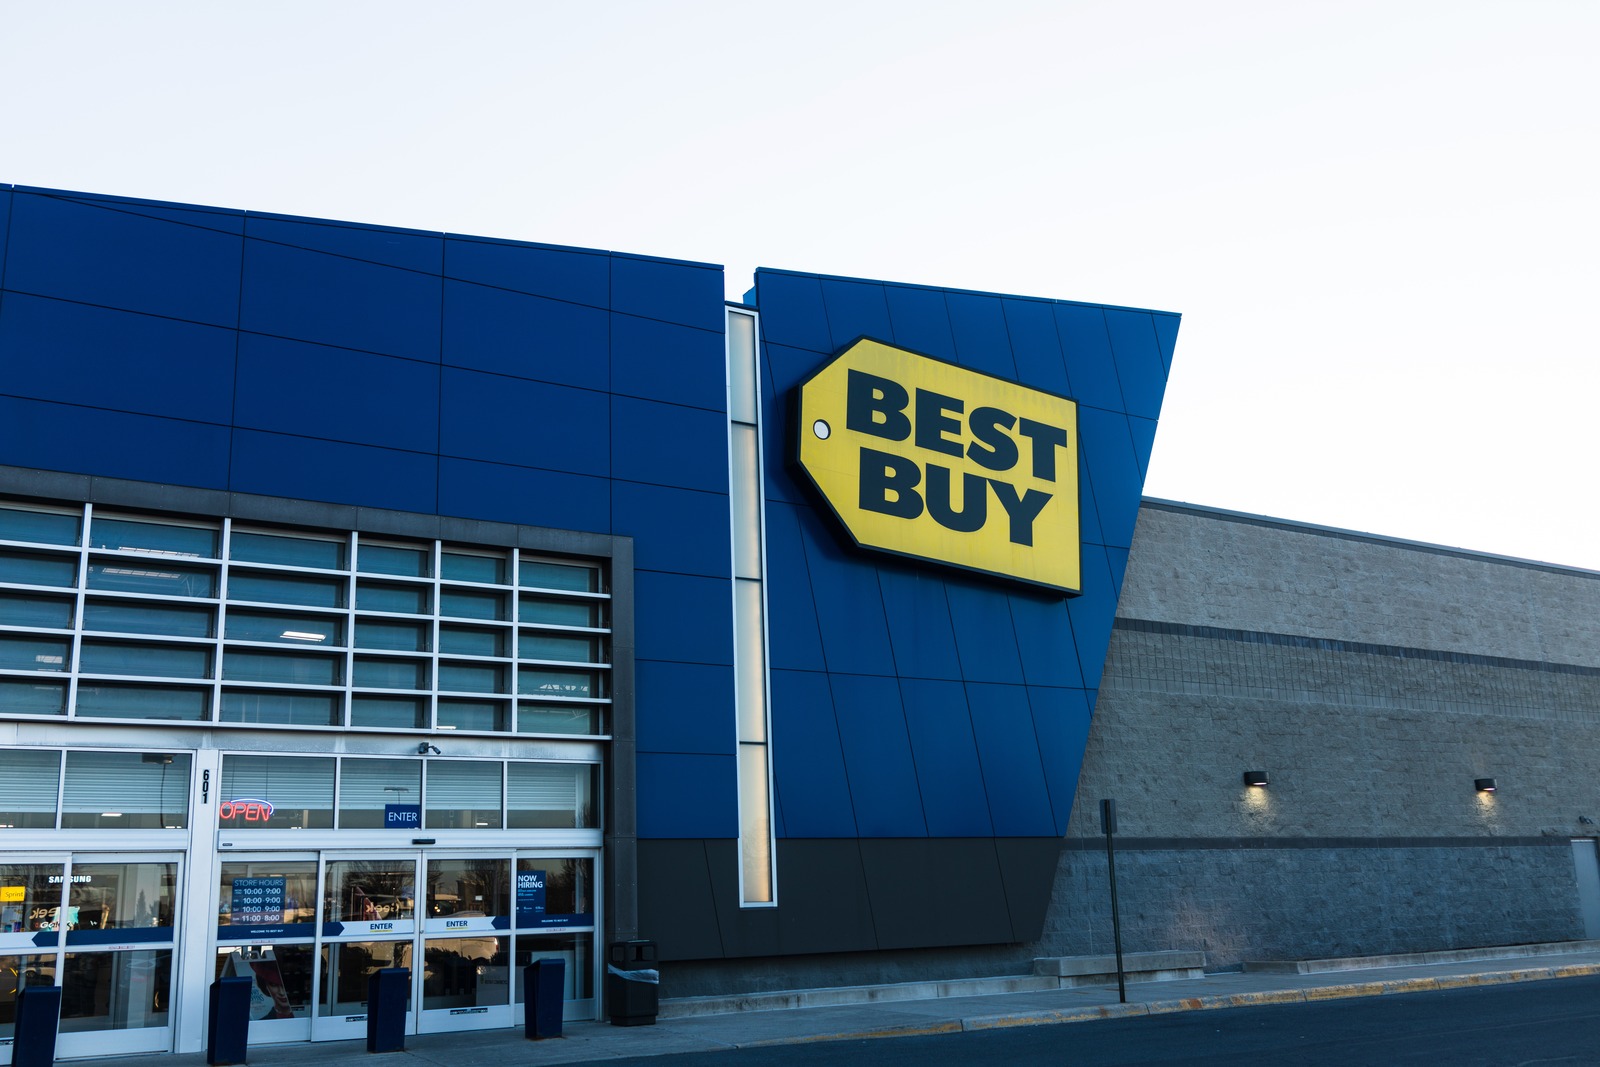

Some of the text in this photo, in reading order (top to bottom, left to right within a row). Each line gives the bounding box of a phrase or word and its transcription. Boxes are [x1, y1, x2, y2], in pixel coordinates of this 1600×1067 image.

[846, 368, 1067, 483] BEST
[859, 446, 1053, 547] BUY
[202, 769, 210, 804] 601
[219, 801, 271, 821] OPEN
[388, 812, 418, 822] ENTER
[5, 891, 24, 899] Sprint
[446, 920, 468, 928] ENTER
